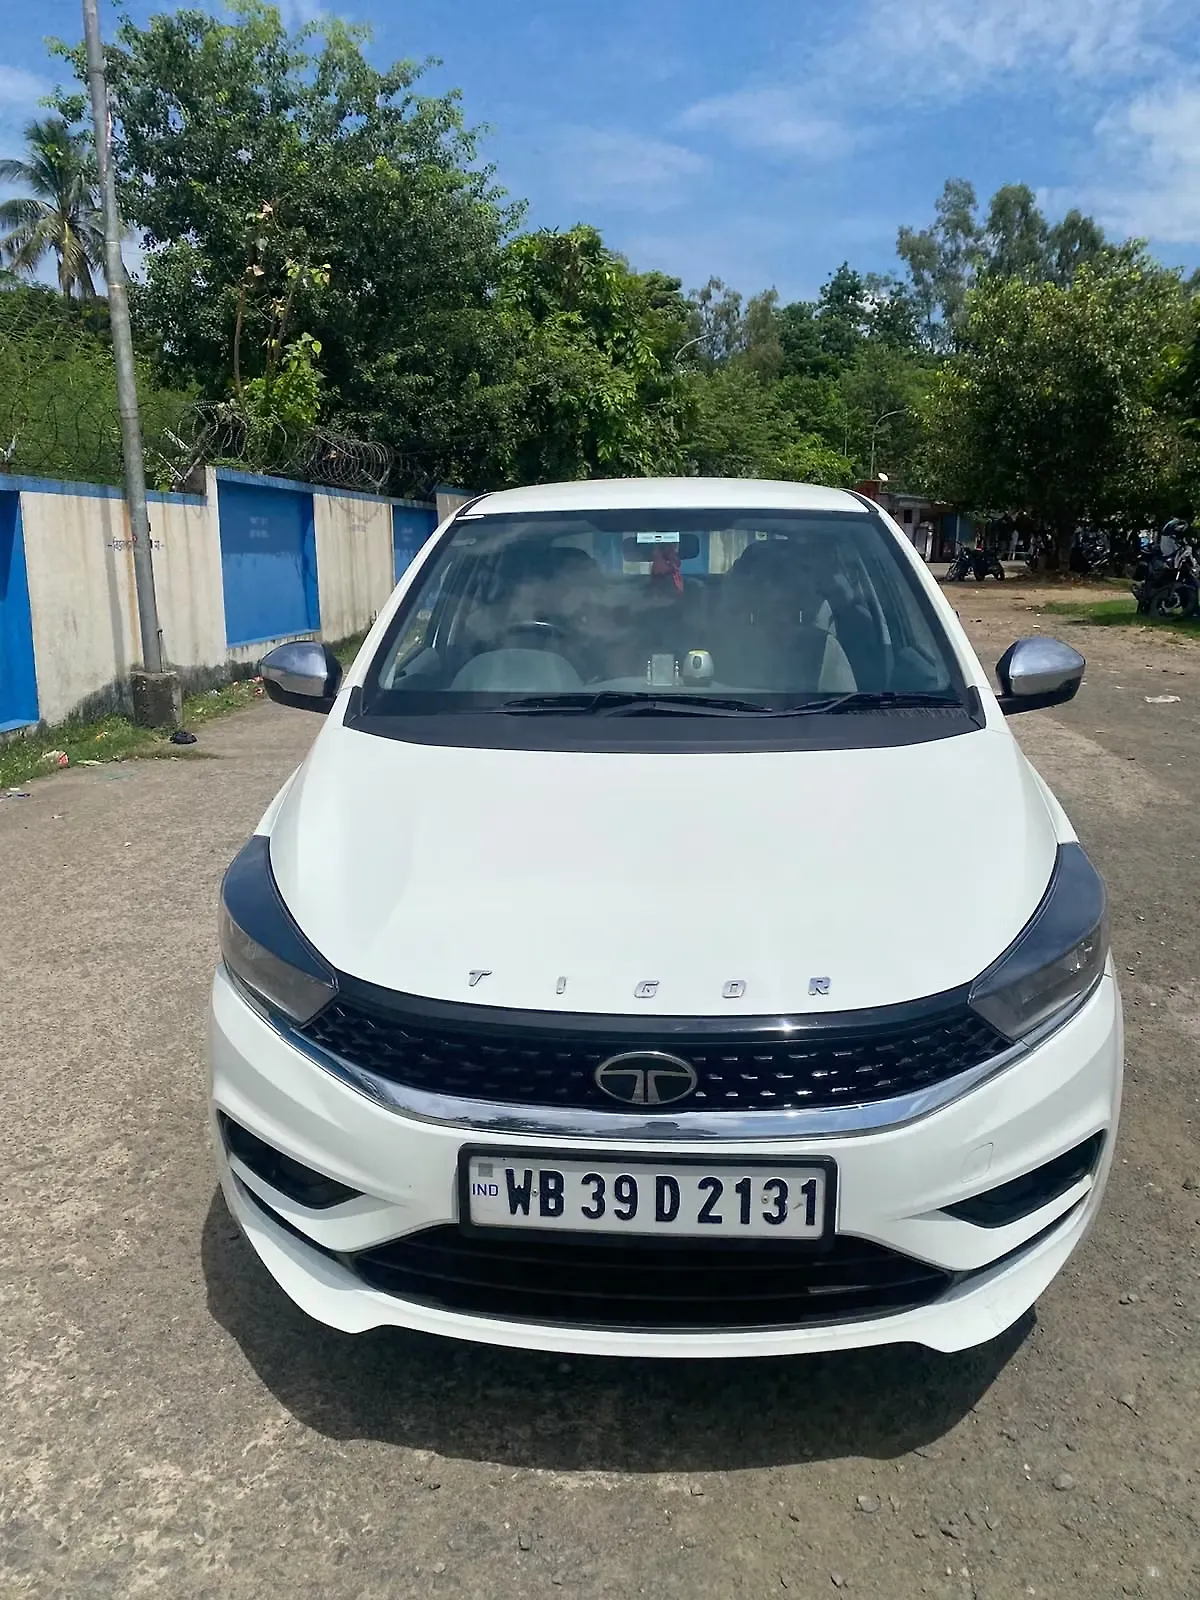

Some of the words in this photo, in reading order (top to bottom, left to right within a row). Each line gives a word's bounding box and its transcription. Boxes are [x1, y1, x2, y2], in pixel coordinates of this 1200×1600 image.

[468, 969, 831, 998] TIGOR
[472, 1183, 499, 1197] IND
[505, 1168, 565, 1216] WB
[581, 1172, 638, 1221] 39
[655, 1175, 680, 1222] D
[697, 1176, 817, 1226] 2131
